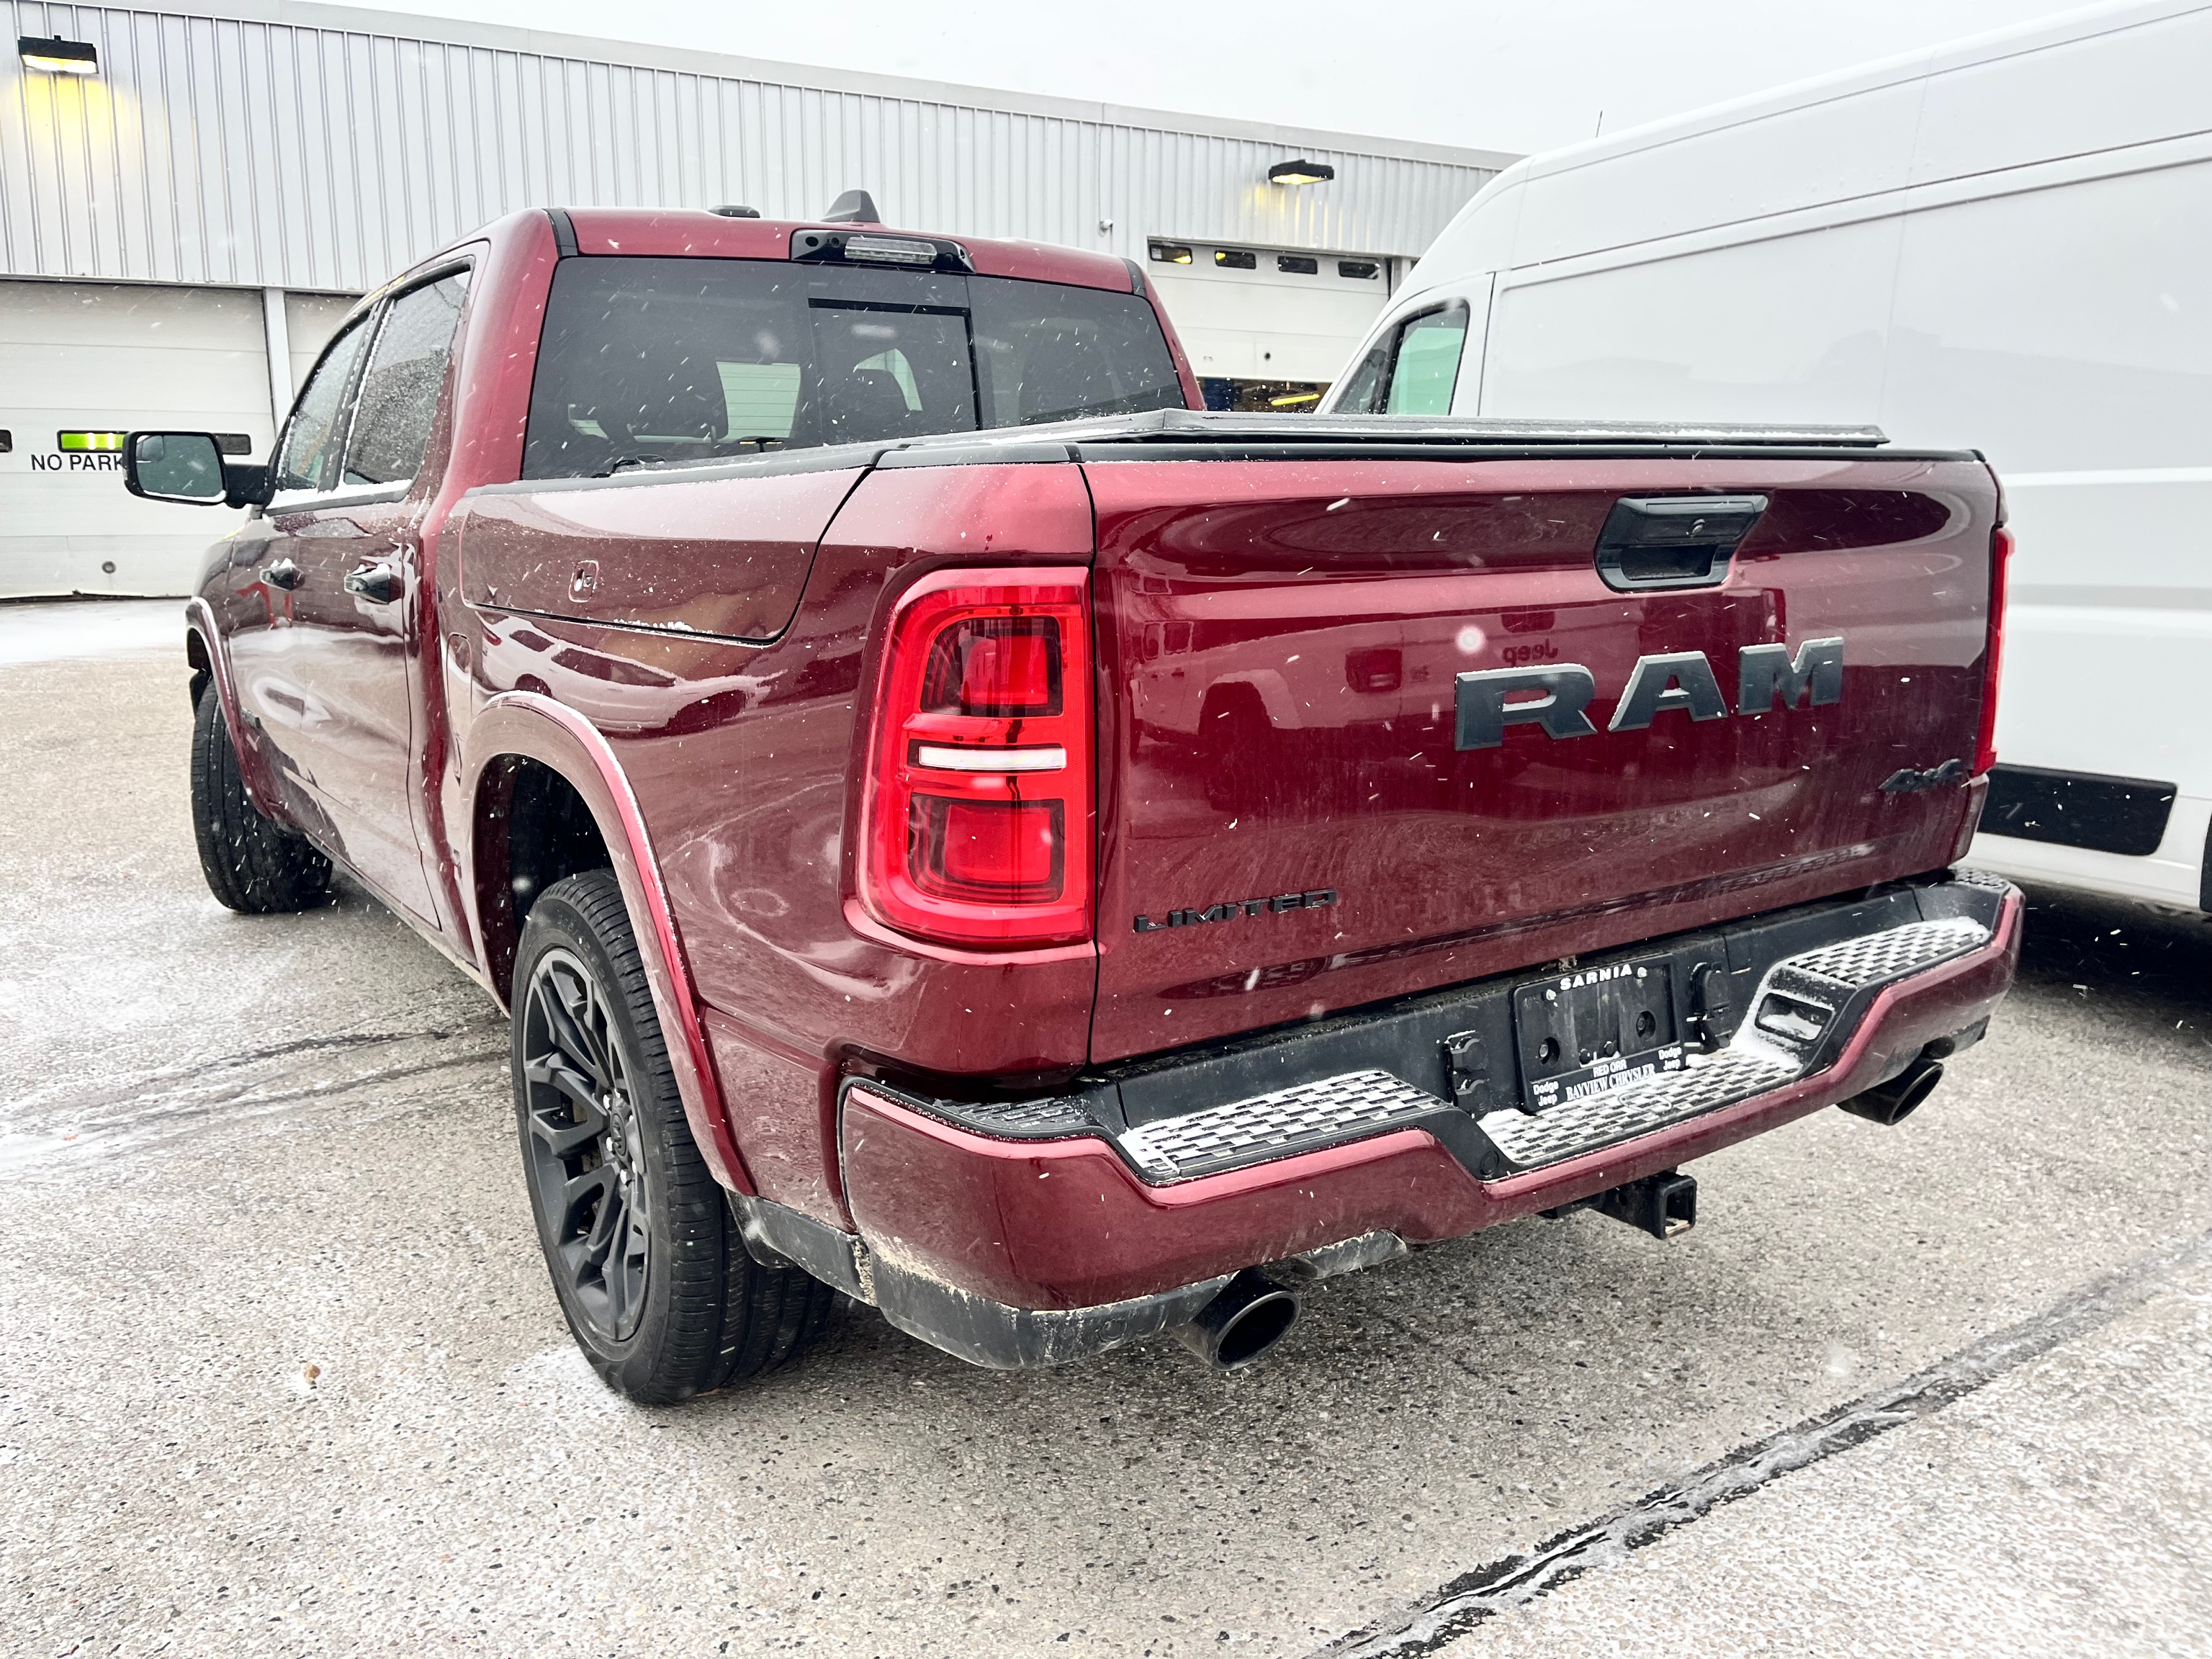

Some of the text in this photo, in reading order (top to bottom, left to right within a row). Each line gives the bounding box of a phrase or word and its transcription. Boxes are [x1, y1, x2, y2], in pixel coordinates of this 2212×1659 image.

[31, 454, 63, 471] NO
[1455, 637, 1843, 751] RAM
[1133, 888, 1337, 933] LIMITED
[1560, 963, 1632, 991] SARNIA
[1658, 1046, 1682, 1061] Dodge
[1593, 1058, 1627, 1078] RED ORR
[1663, 1058, 1681, 1071] Jeep
[1533, 1081, 1559, 1096] Dodge
[1565, 1063, 1655, 1102] BAYVIEW CHRYSLER
[1538, 1093, 1558, 1107] Jeep
